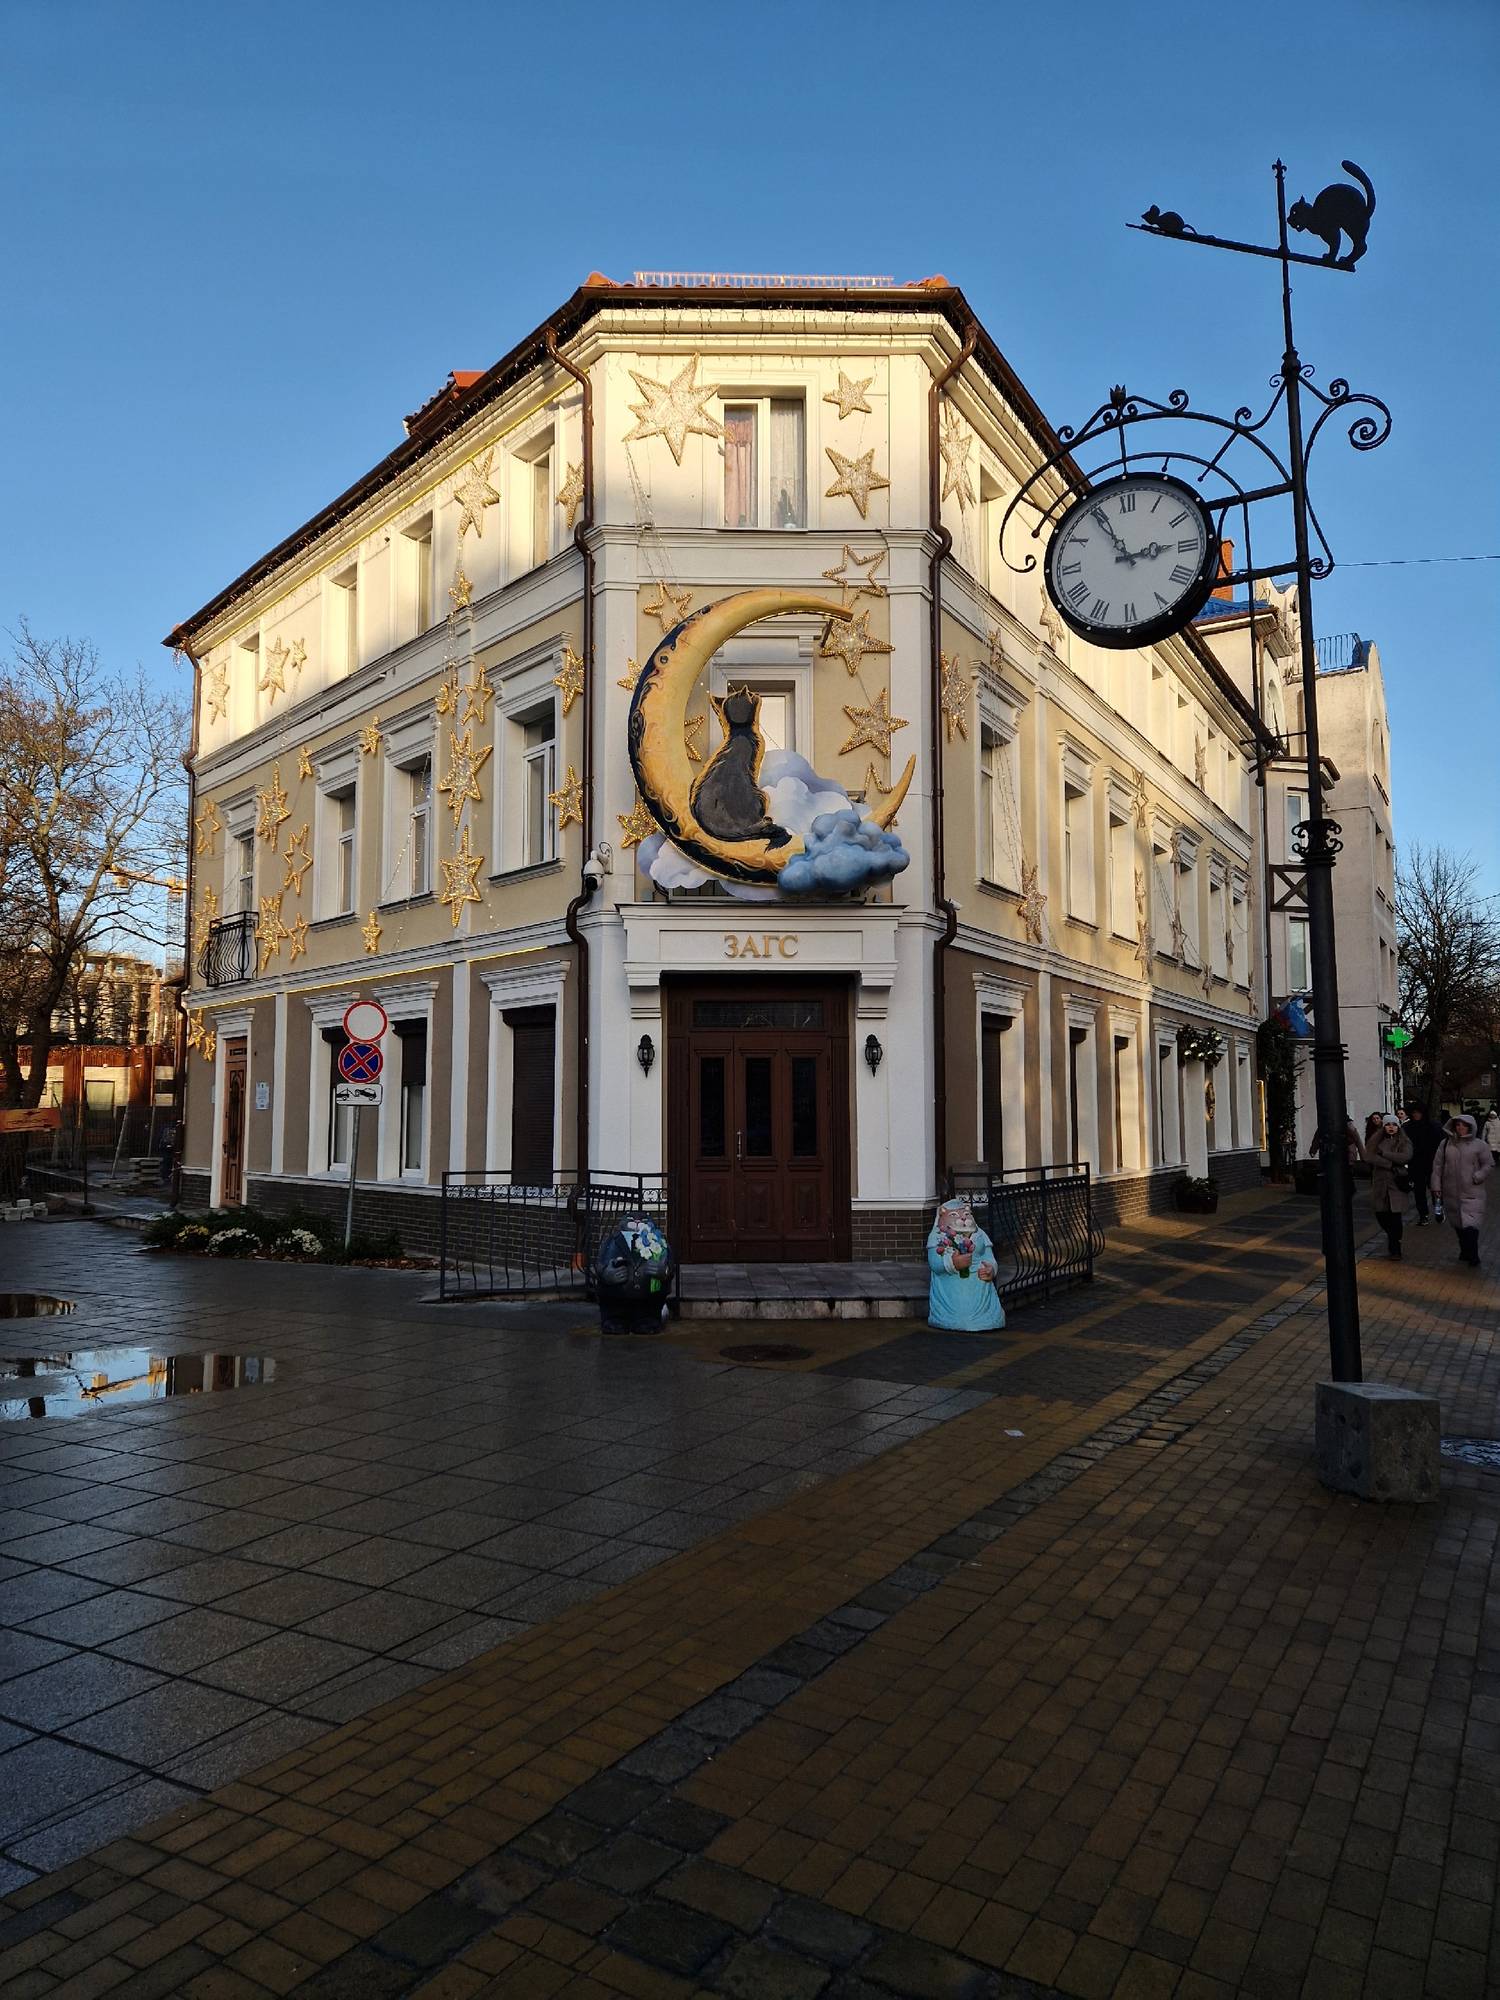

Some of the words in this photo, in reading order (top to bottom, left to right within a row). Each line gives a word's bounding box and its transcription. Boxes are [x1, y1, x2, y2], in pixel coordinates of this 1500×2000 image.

[1119, 493, 1136, 514] XII
[1168, 510, 1191, 529] II
[1069, 534, 1089, 548] X
[1177, 538, 1199, 554] III
[1062, 560, 1082, 576] IX
[1168, 564, 1195, 586] IIII
[1066, 580, 1092, 608] VIII
[1153, 591, 1170, 610] V
[1090, 599, 1110, 622] VII
[1124, 602, 1138, 622] VI
[724, 934, 799, 959] ЗАГС
